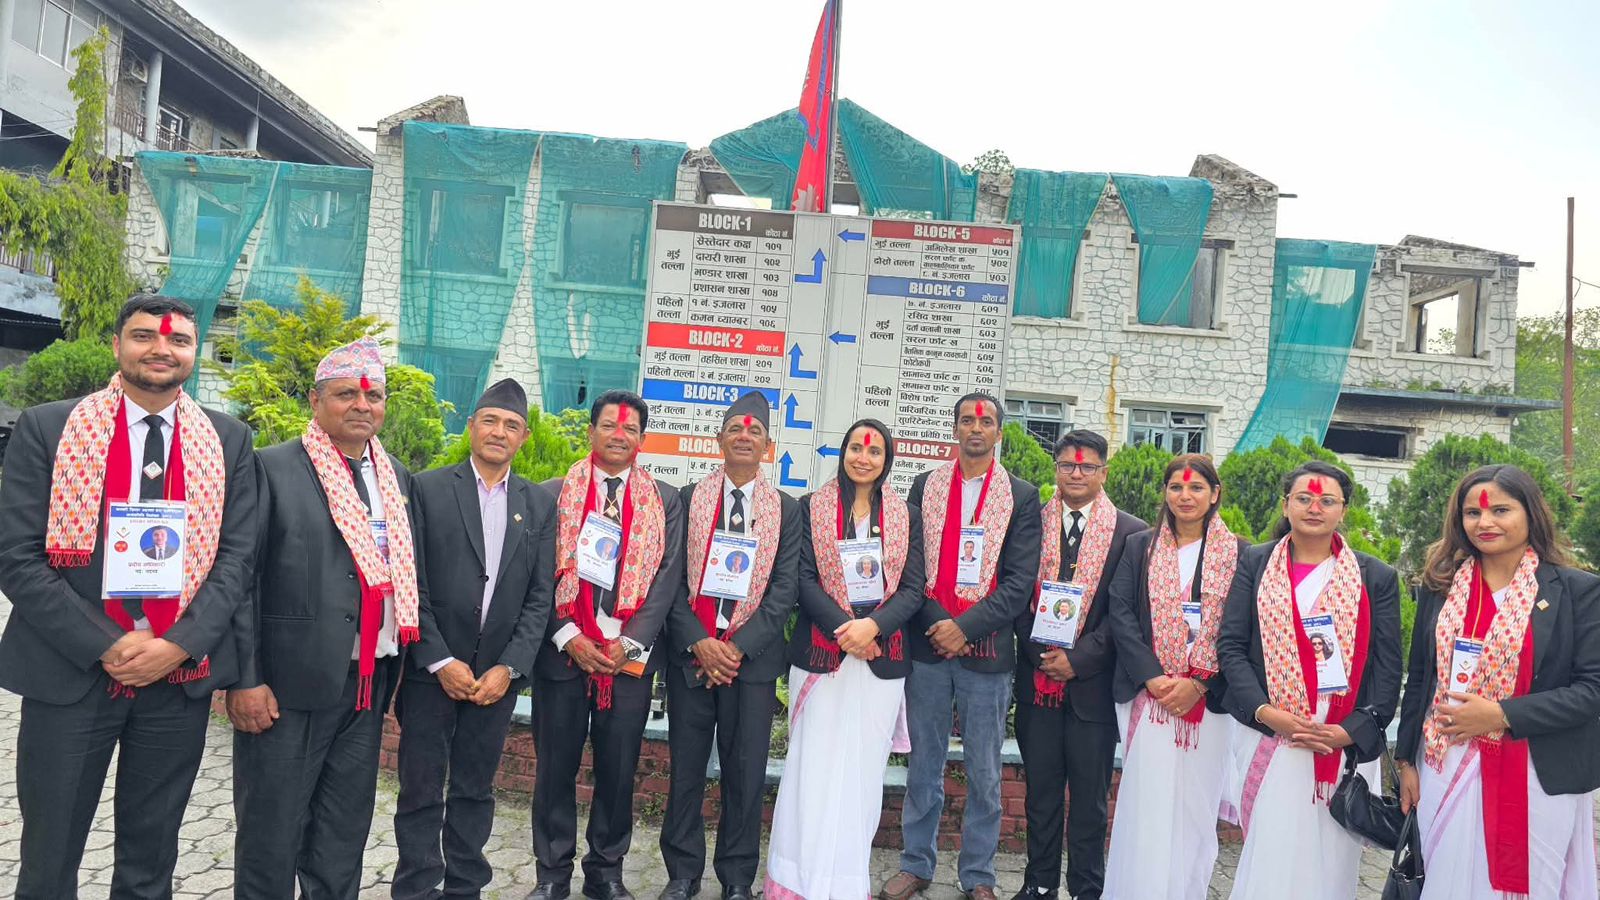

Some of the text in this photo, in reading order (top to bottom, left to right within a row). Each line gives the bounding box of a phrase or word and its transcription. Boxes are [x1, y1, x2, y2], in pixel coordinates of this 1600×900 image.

[699, 213, 751, 231] BLOCK-1
[914, 225, 970, 240] BLOCK-5
[734, 240, 752, 249] कक्ष
[765, 242, 782, 251] १०१
[890, 241, 911, 249] तल्ला
[696, 252, 746, 264] दायरी शाखा
[764, 258, 780, 267] १०२
[893, 258, 915, 267] तल्ला
[661, 261, 685, 271] तल्ला
[694, 268, 748, 280] भण्डार शाखा
[762, 274, 780, 283] १०३
[693, 283, 750, 295] प्रशासन शाखा
[762, 289, 778, 297] १०४
[908, 282, 966, 298] BLOCK-6
[657, 296, 683, 308] पहिलो
[713, 300, 746, 310] इजलास
[930, 302, 962, 311] इजलास
[760, 305, 777, 314] १०५
[657, 310, 680, 319] तल्ला
[931, 314, 952, 322] शाखा
[759, 320, 776, 328] १०६
[870, 332, 894, 340] तल्ला
[979, 330, 996, 338] ६०३
[688, 330, 744, 348] BLOCK-2
[669, 352, 691, 361] तल्ला
[729, 357, 749, 366] शाखा
[756, 360, 772, 368] २०१
[647, 366, 695, 378] पहिलो तल्ला
[976, 366, 994, 374] ६०६
[718, 373, 746, 382] इजलास
[754, 376, 771, 384] २०२
[683, 384, 739, 402] BLOCK-3
[864, 384, 892, 396] पहिलो
[865, 399, 890, 407] तल्ला
[664, 405, 686, 415] तल्ला
[648, 418, 690, 431] हिलो तल्ला
[896, 442, 951, 458] BLOCK-7
[654, 465, 678, 476] तल्ला
